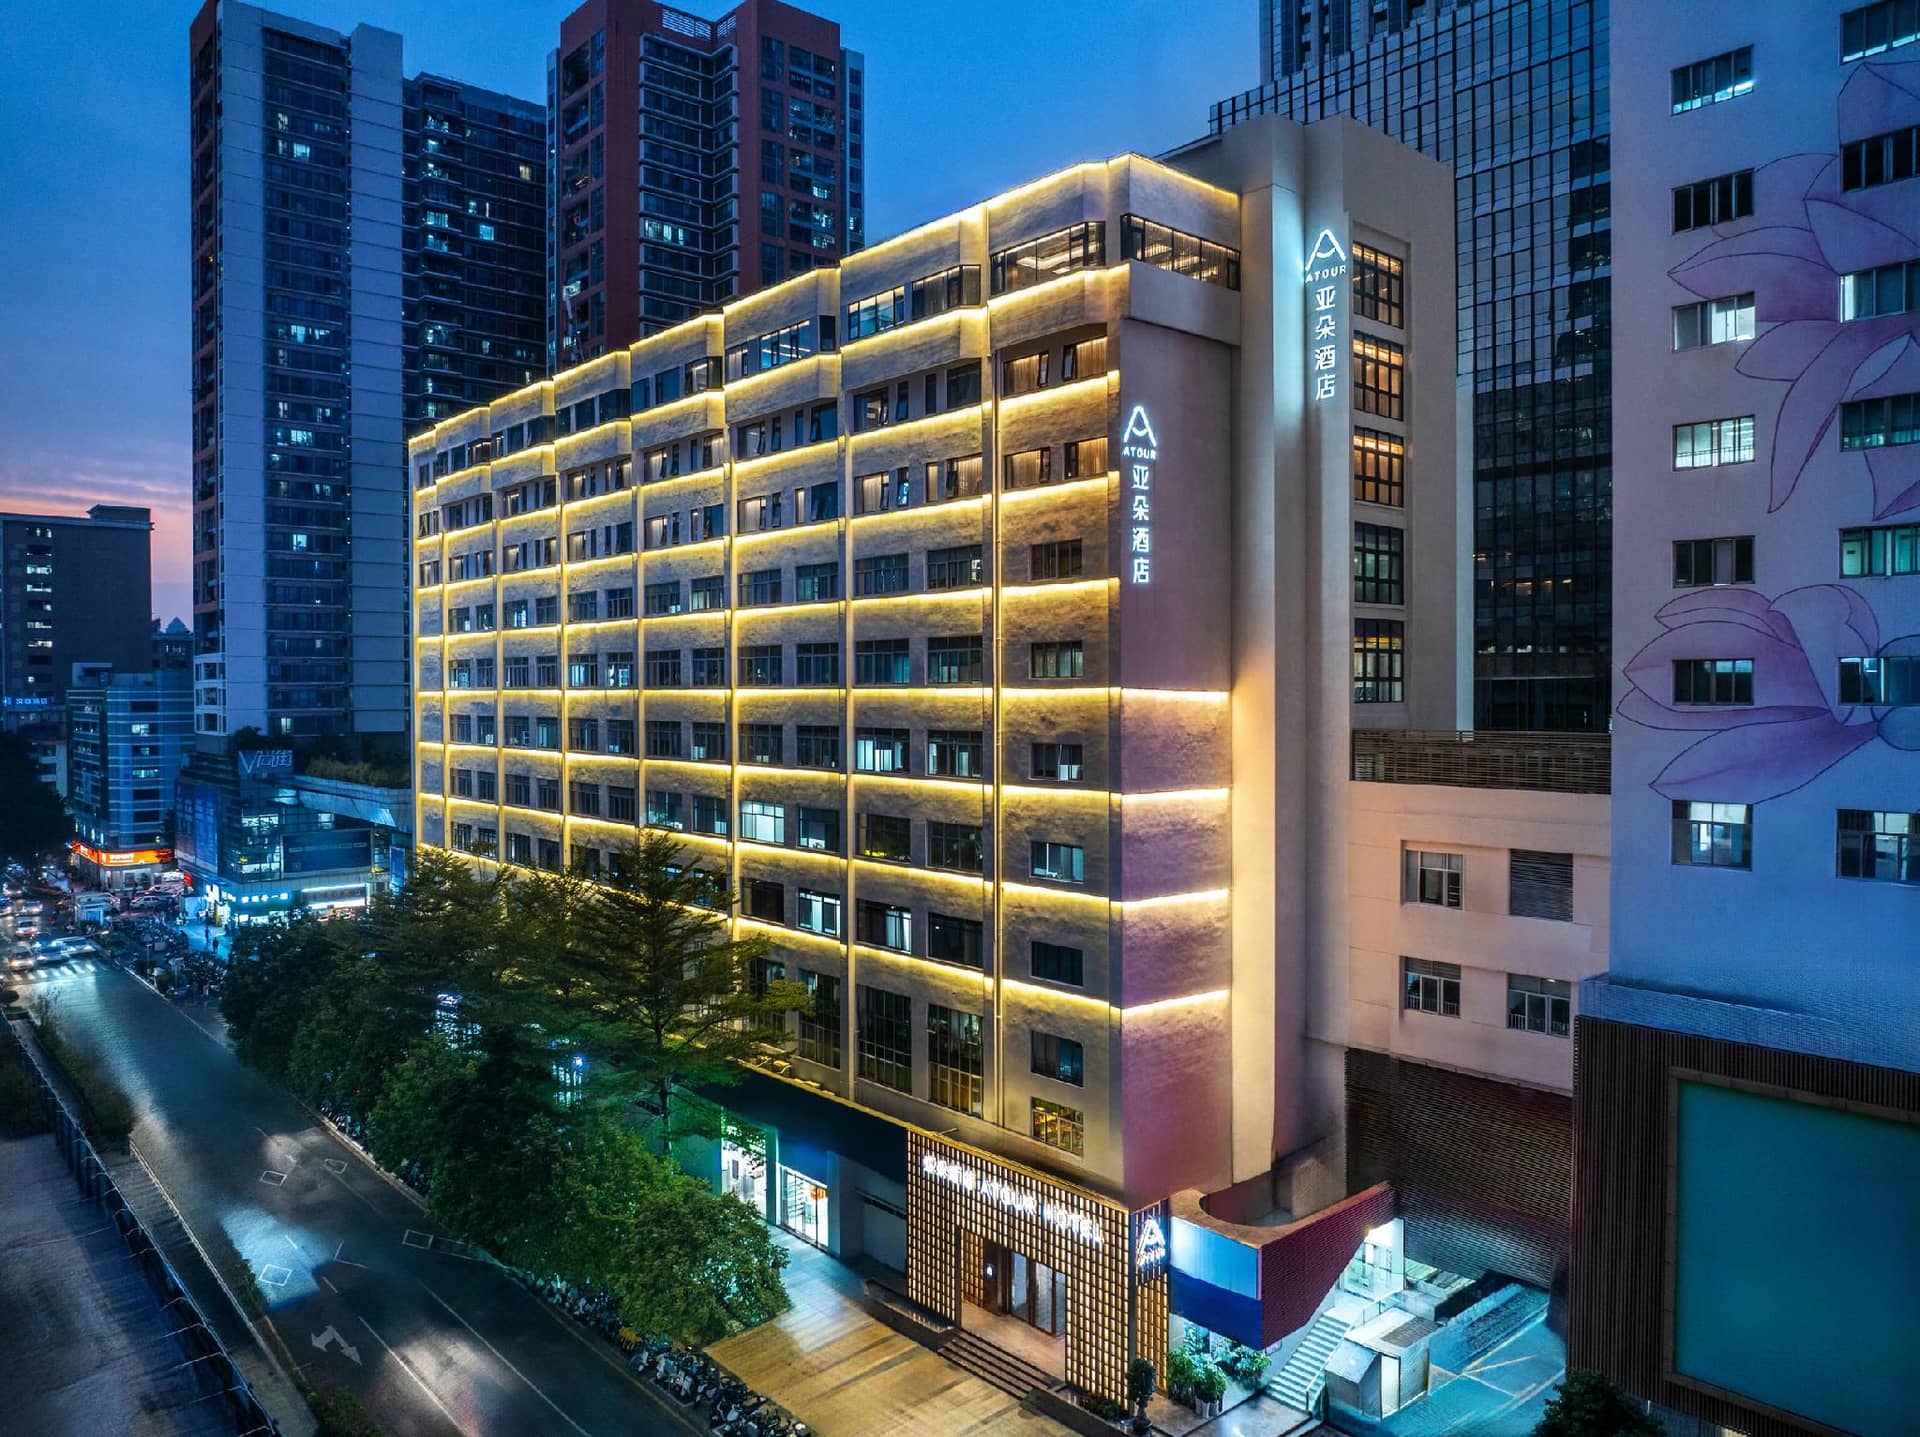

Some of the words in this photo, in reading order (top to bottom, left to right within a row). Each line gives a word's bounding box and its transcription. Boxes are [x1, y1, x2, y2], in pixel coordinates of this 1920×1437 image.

[1305, 264, 1347, 283] ATOUR
[1315, 285, 1336, 400] 亚朵酒店
[1122, 446, 1157, 460] ATOUR
[1131, 464, 1150, 584] 亚朵酒店
[980, 1179, 1037, 1216] ATOUR
[1043, 1202, 1103, 1245] HOTEL
